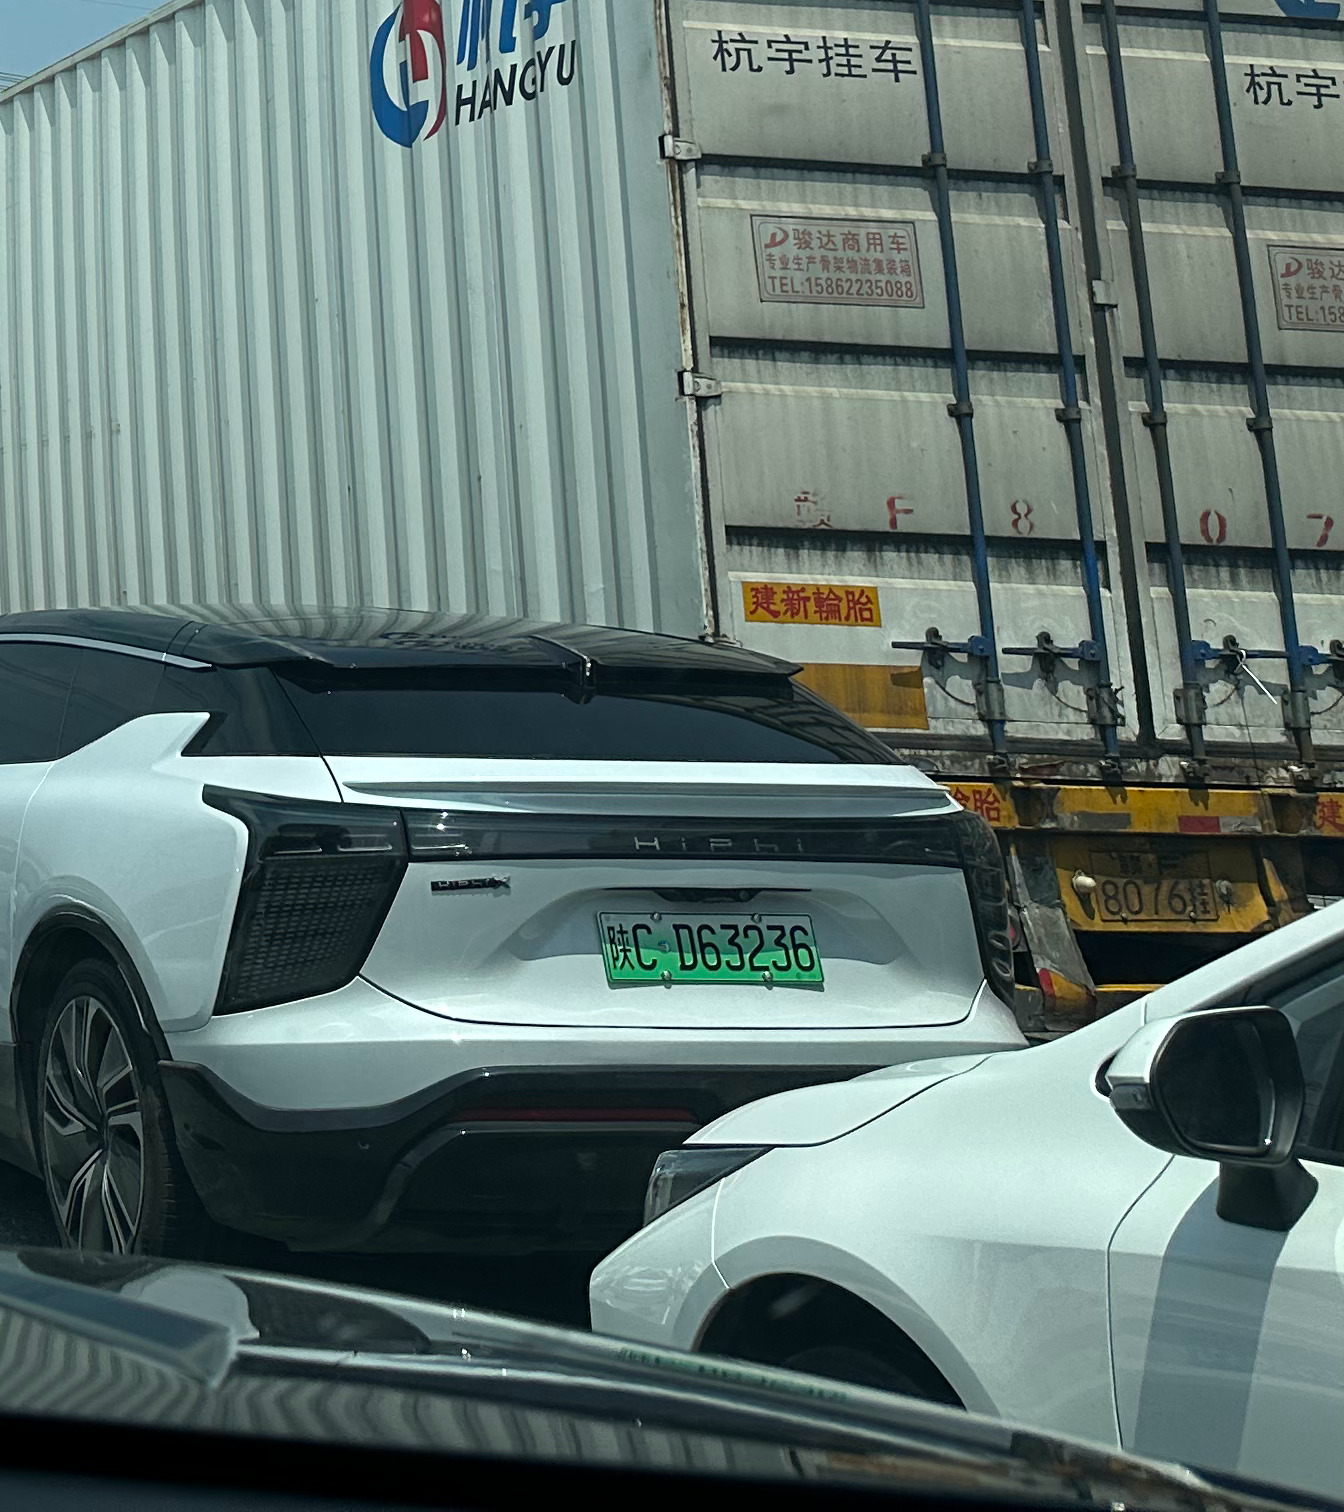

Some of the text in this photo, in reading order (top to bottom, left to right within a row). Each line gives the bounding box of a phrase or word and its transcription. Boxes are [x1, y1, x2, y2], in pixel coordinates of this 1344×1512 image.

[711, 30, 918, 83] 杭宇挂车
[455, 40, 577, 126] HANGYU
[1243, 64, 1341, 109] 杭宇
[792, 228, 909, 254] 骏达商用车
[765, 252, 912, 278] 专业生产骨架物流集装箱
